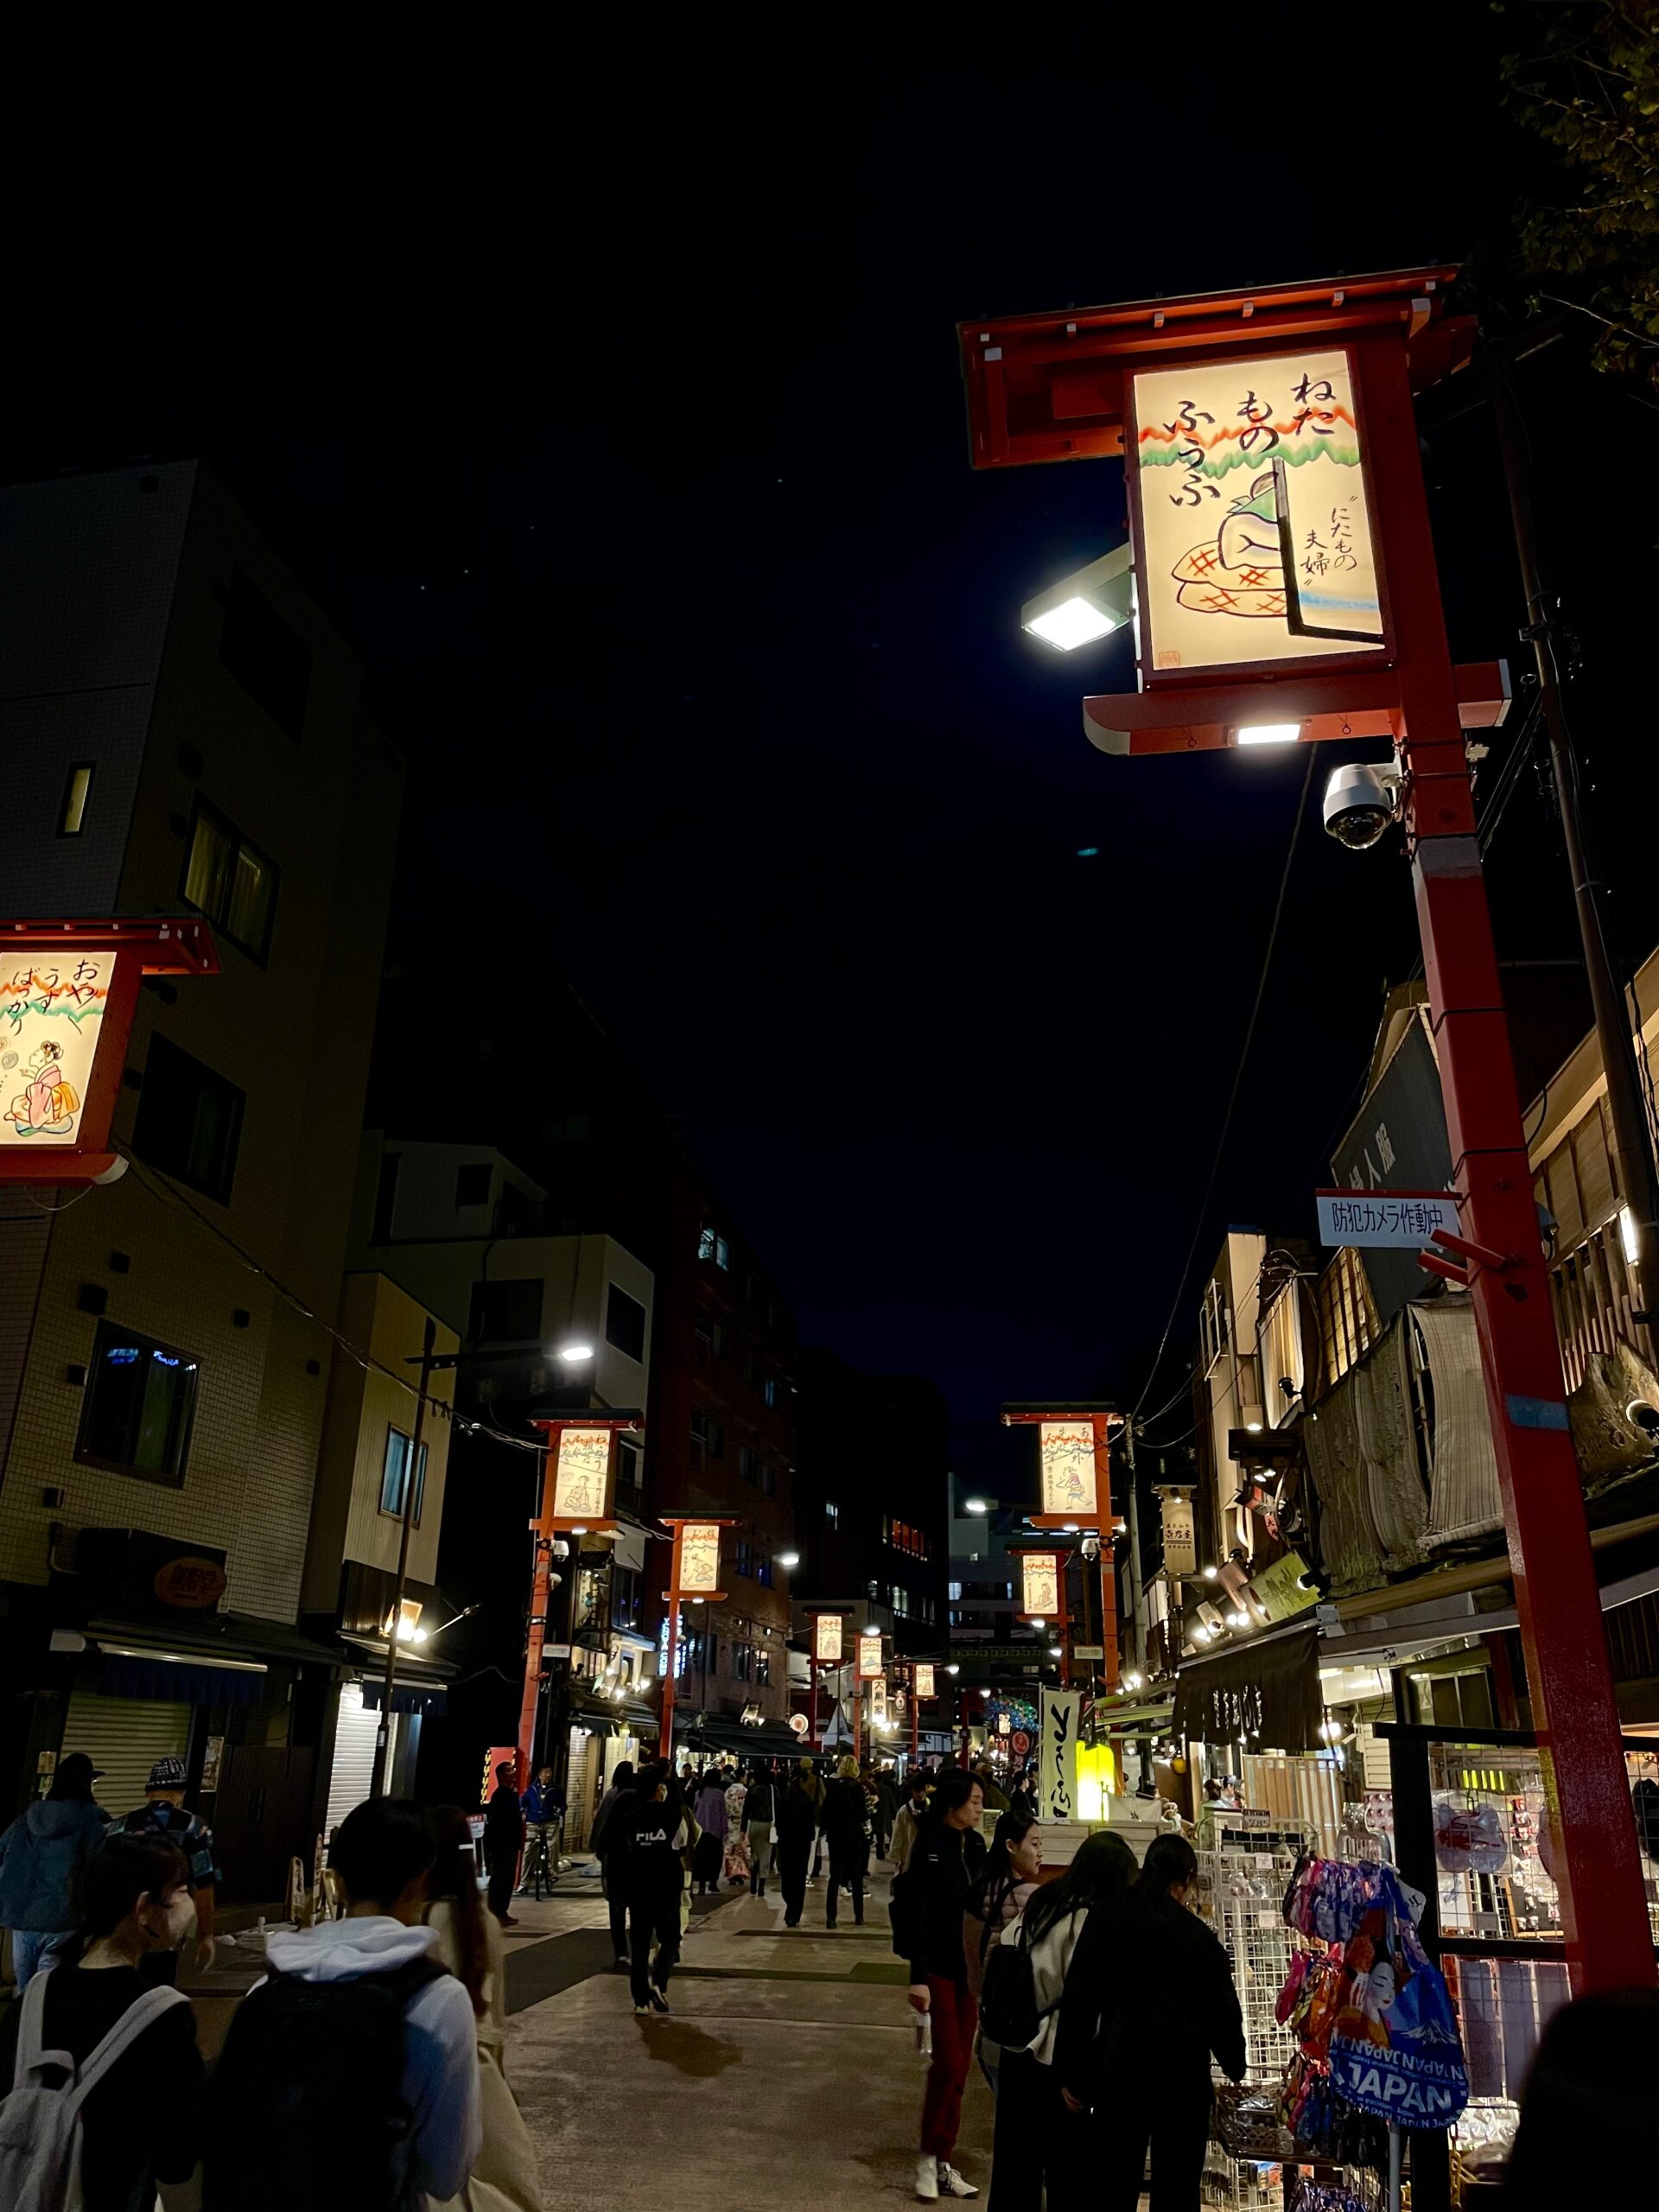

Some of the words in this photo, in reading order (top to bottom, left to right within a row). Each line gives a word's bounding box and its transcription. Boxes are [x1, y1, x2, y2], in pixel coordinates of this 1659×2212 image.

[1237, 390, 1279, 454] もの
[1291, 372, 1336, 435] ねた
[1162, 399, 1221, 508] ふうふ
[1332, 1203, 1444, 1235] 防犯カメラ作動中
[636, 1828, 666, 1841] FILA
[1348, 2061, 1452, 2113] JAPAN
